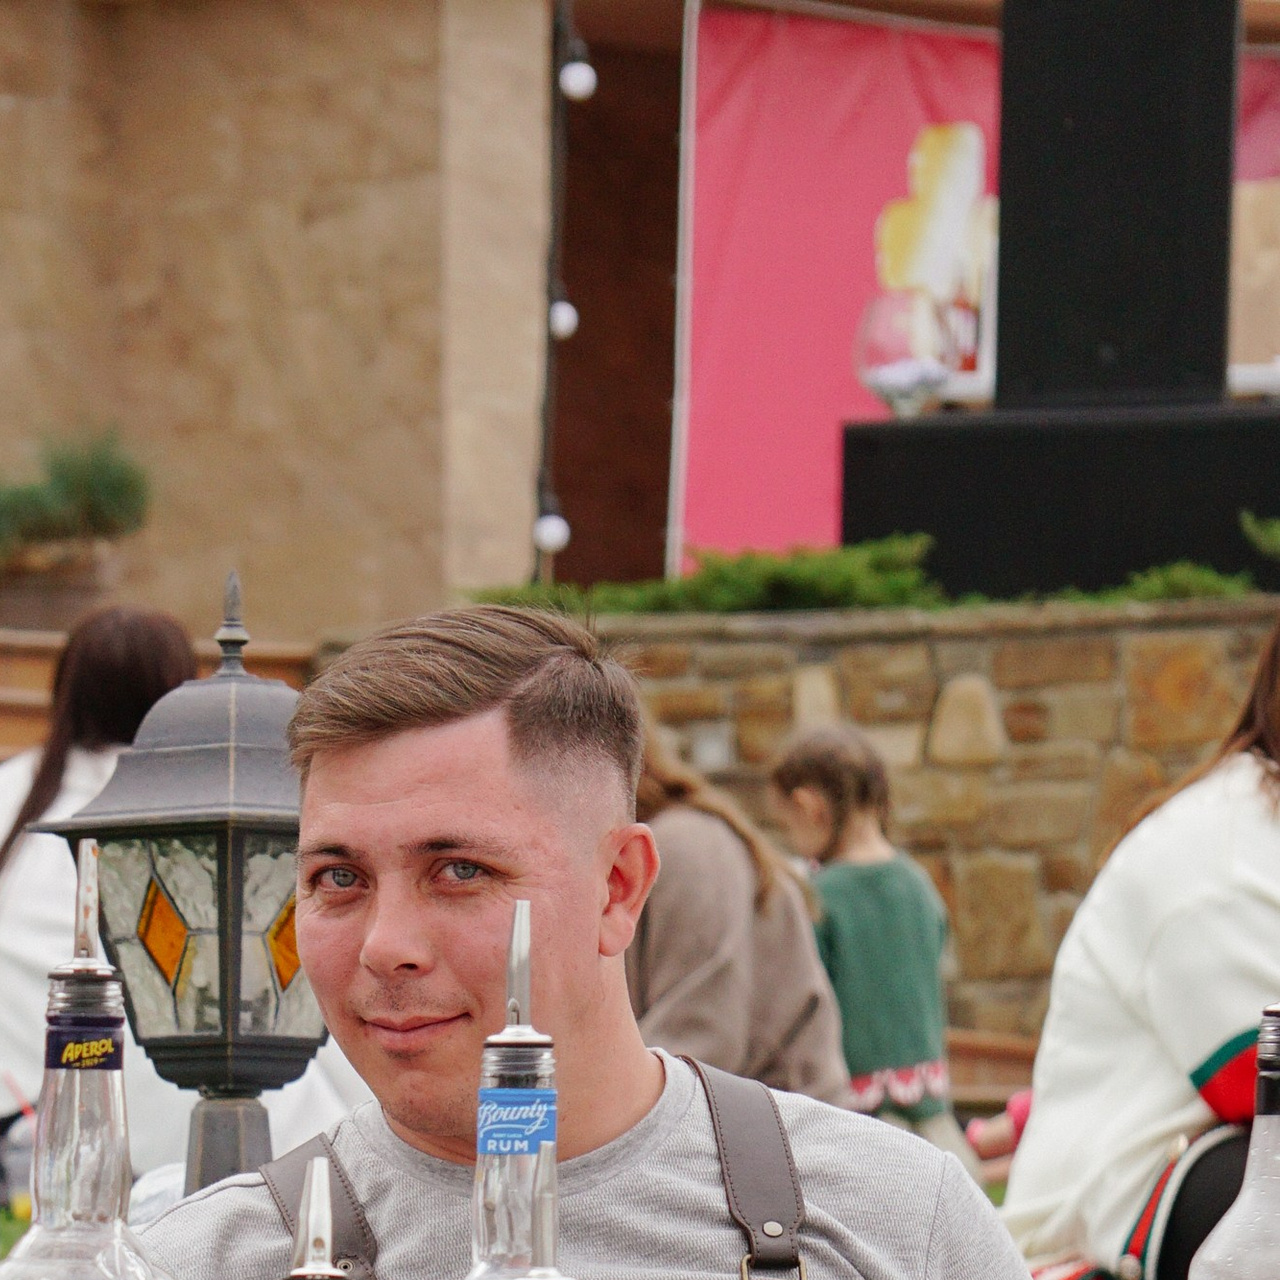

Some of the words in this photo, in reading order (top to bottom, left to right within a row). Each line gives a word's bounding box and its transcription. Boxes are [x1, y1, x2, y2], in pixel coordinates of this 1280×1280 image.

[61, 1037, 114, 1064] APEROL
[478, 1098, 550, 1138] Bounty
[487, 1139, 529, 1151] RUM
